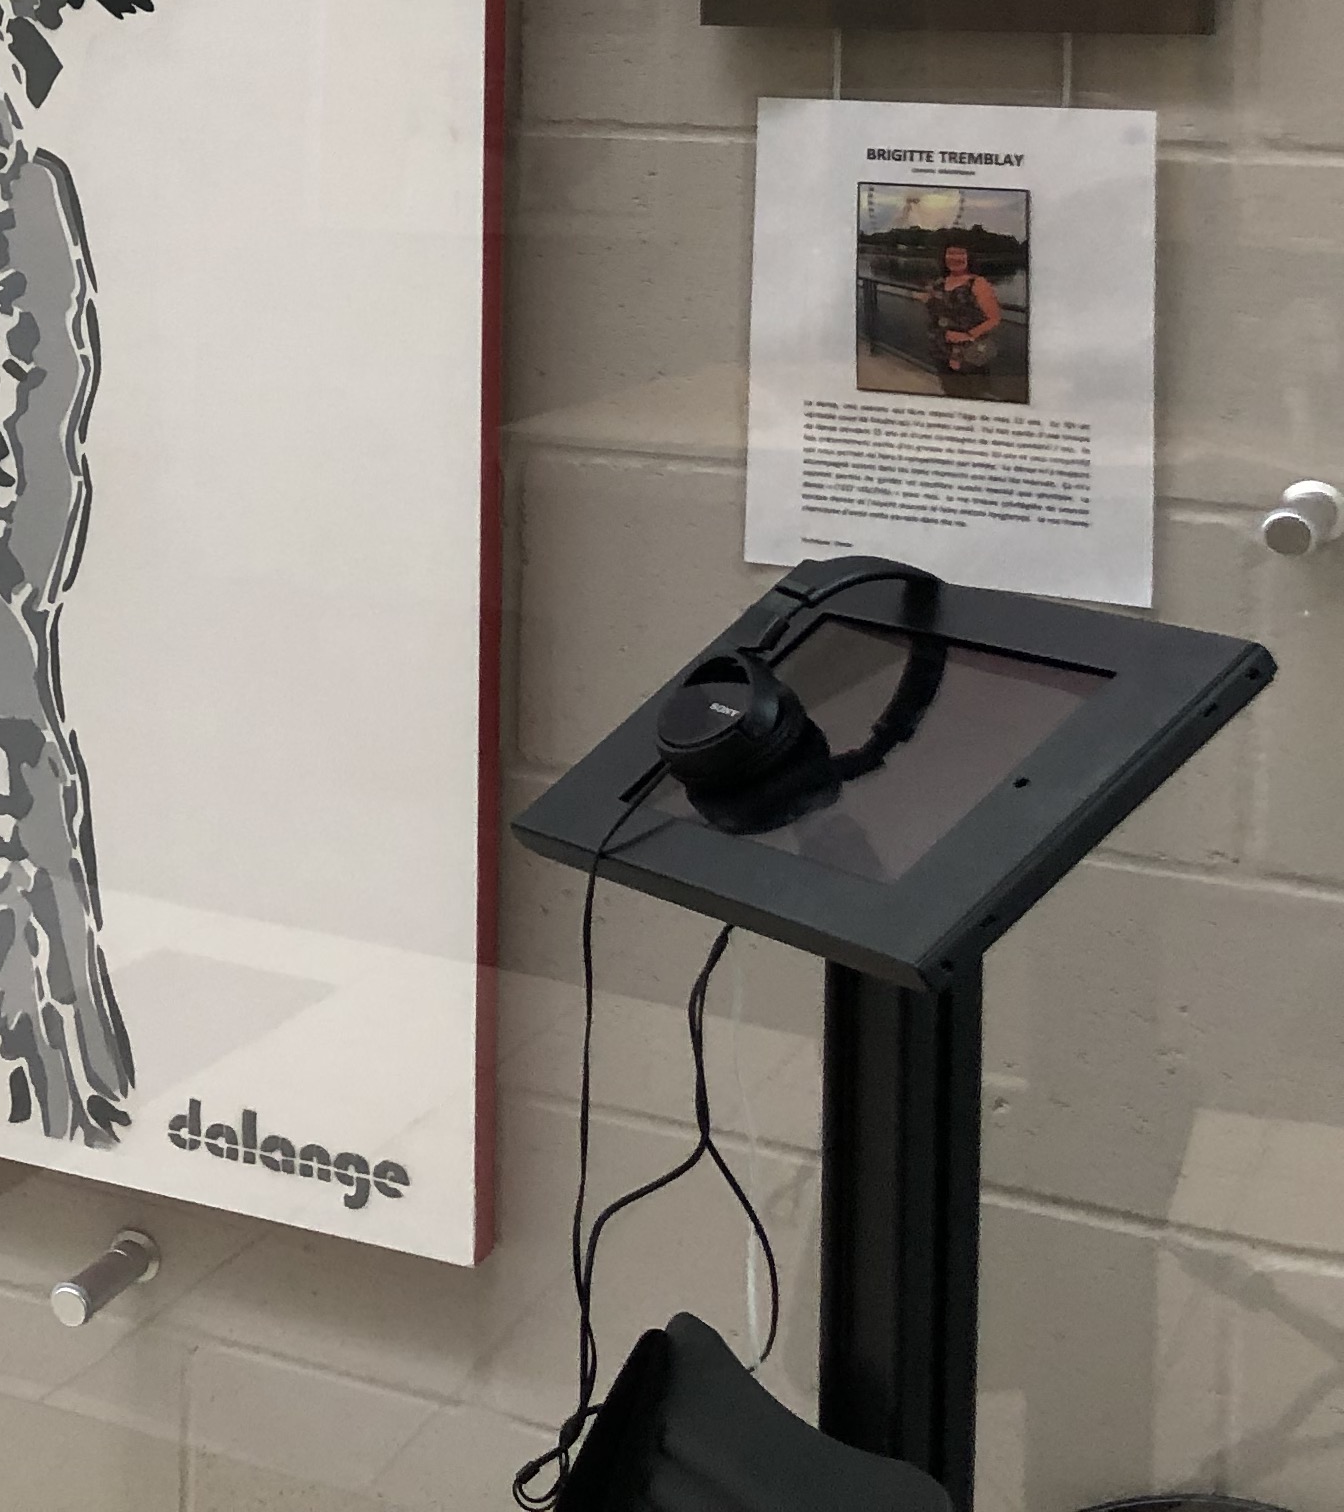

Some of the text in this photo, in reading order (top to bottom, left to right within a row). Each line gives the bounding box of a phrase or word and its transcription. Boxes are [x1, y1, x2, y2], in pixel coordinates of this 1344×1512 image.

[867, 148, 1024, 167] BRIGITTE TREMBLAY
[709, 702, 740, 717] SONY
[167, 1097, 411, 1210] dalange
